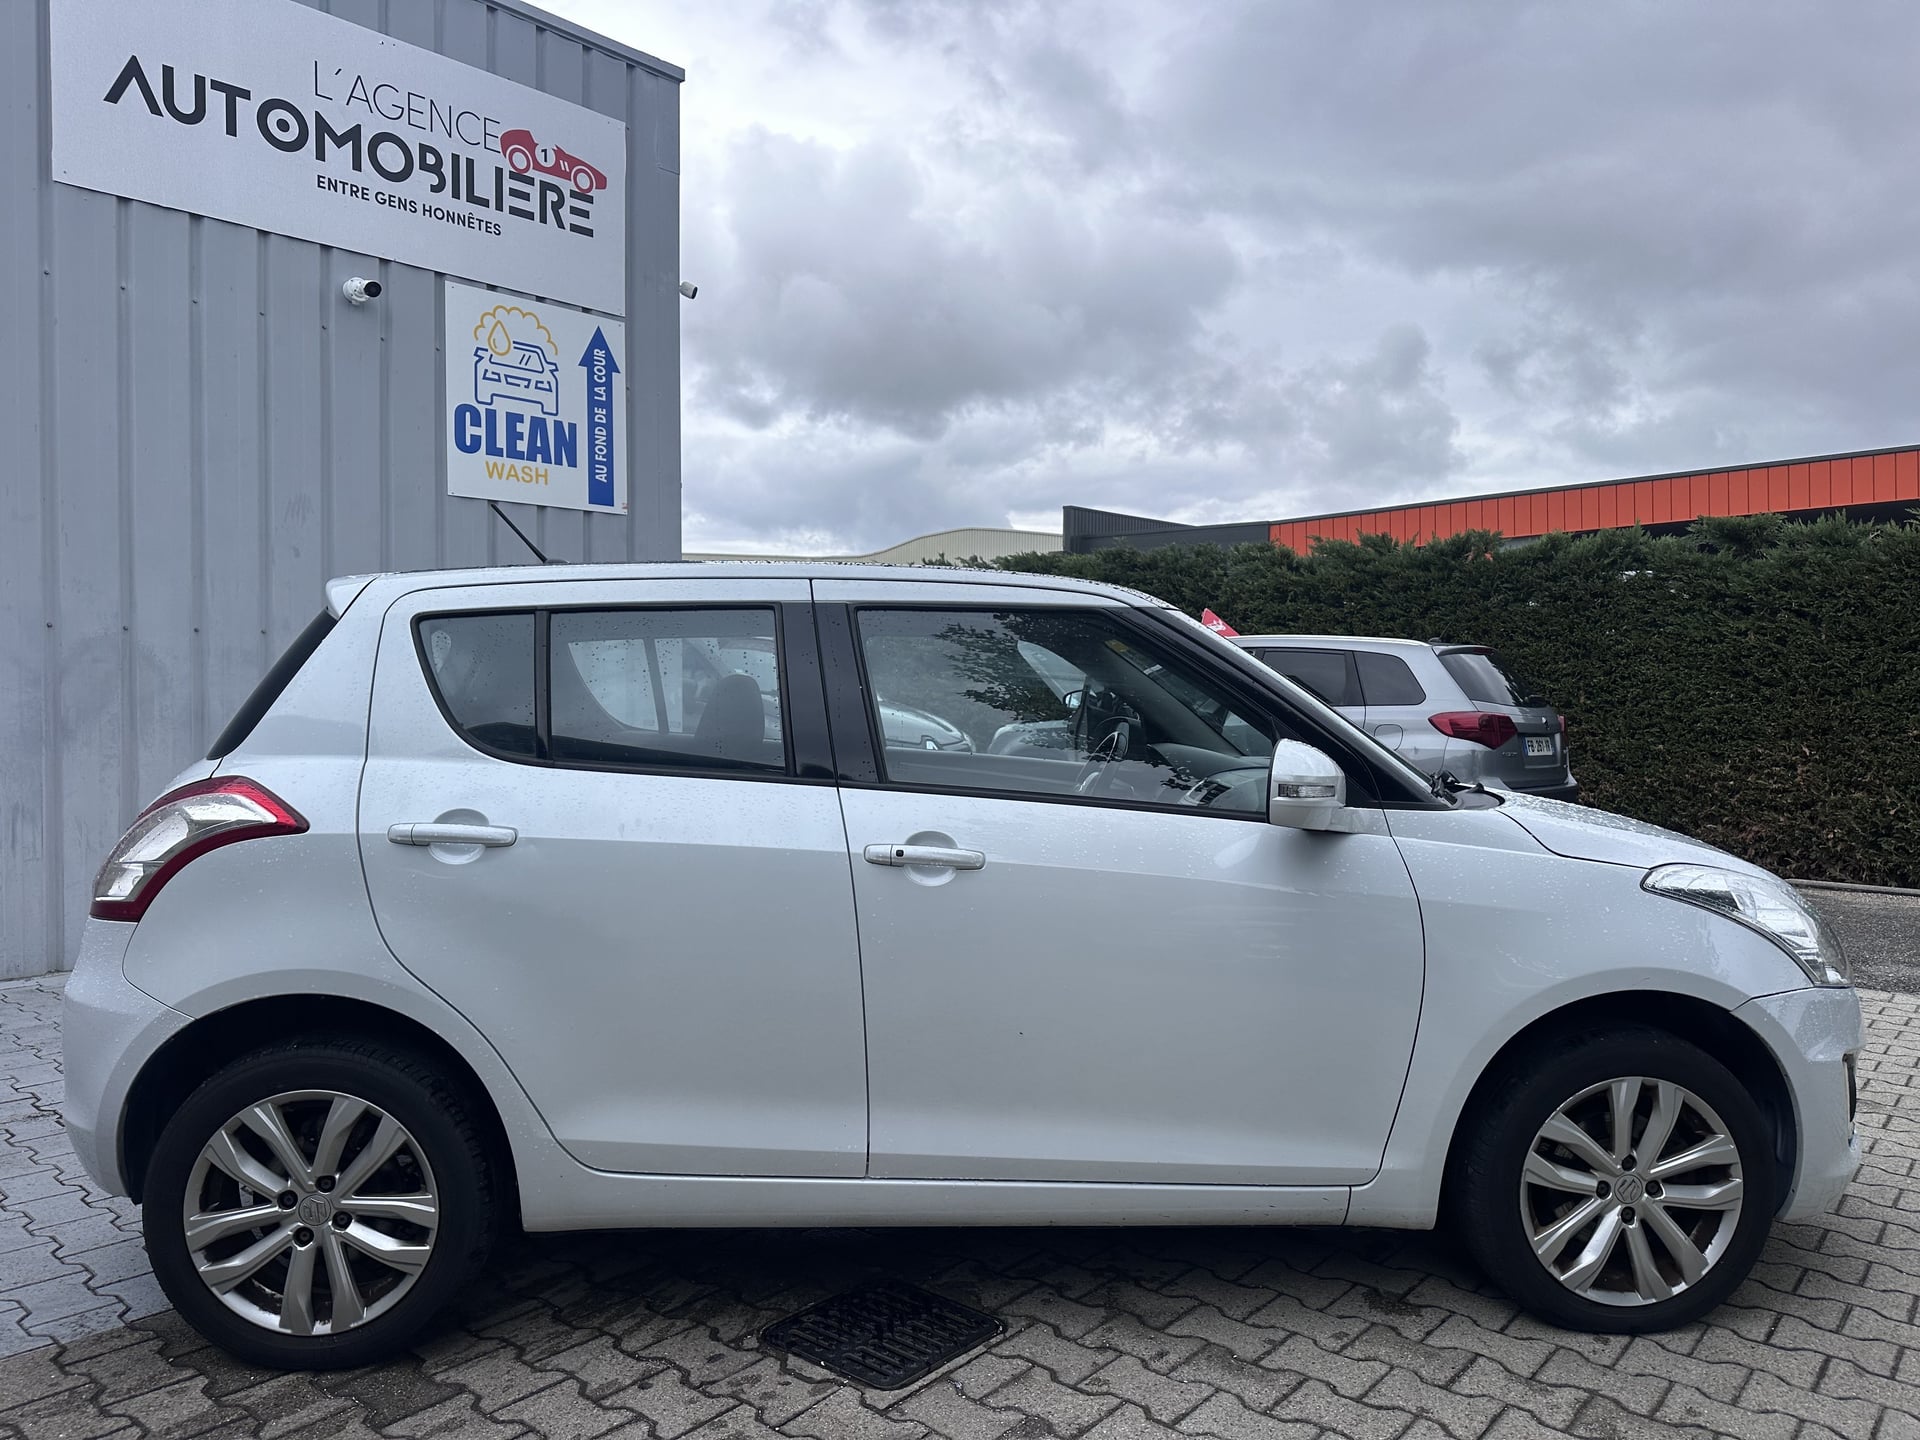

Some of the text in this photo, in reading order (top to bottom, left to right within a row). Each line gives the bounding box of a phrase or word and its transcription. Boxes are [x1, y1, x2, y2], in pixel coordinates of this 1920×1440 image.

[314, 60, 501, 154] L'AGENCE
[541, 148, 548, 163] 1
[316, 174, 502, 236] ENTRE GENS HONNÊTES
[454, 403, 578, 468] CLEAN
[593, 348, 607, 483] AU FOND DE LA COUR
[485, 460, 549, 485] WASH
